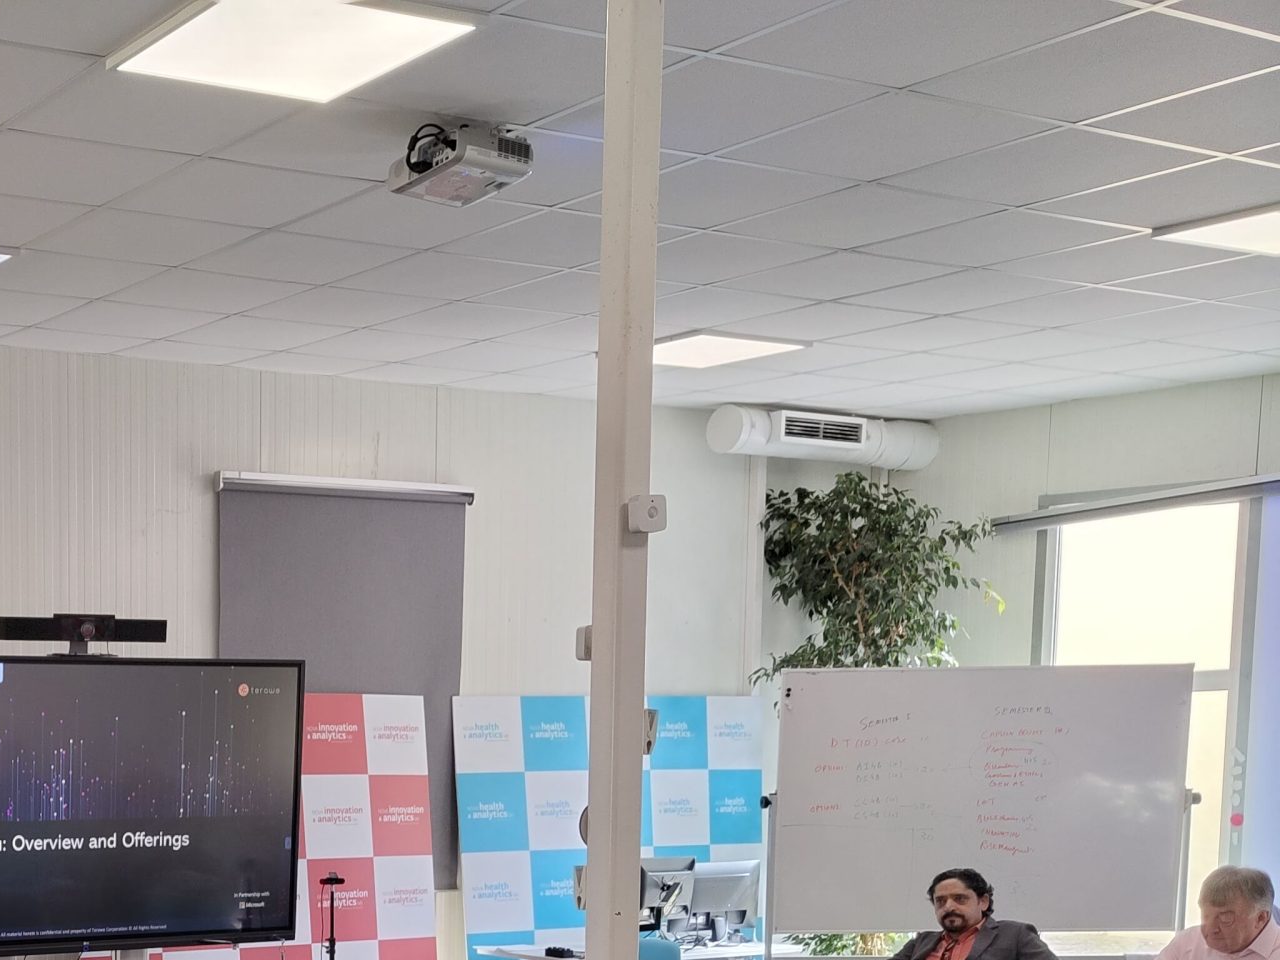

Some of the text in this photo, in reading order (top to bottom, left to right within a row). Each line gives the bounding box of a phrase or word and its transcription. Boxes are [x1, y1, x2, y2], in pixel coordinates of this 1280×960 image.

[318, 723, 358, 732] innovation
[475, 723, 499, 731] health
[541, 722, 564, 730] health
[312, 732, 346, 742] analytics
[378, 732, 408, 742] analytics
[468, 731, 502, 740] analytics
[535, 730, 568, 740] analytics
[324, 806, 363, 814] innovation
[389, 805, 424, 814] innovation
[480, 802, 504, 810] health
[383, 814, 414, 824] analytics
[473, 810, 508, 820] analytics
[318, 815, 352, 826] analytics
[12, 834, 84, 851] Overview
[88, 832, 117, 850] and
[122, 832, 190, 850] Offerings
[484, 881, 509, 890] health
[394, 888, 428, 896] innovation
[478, 890, 512, 900] analytics
[388, 896, 418, 905] analytics
